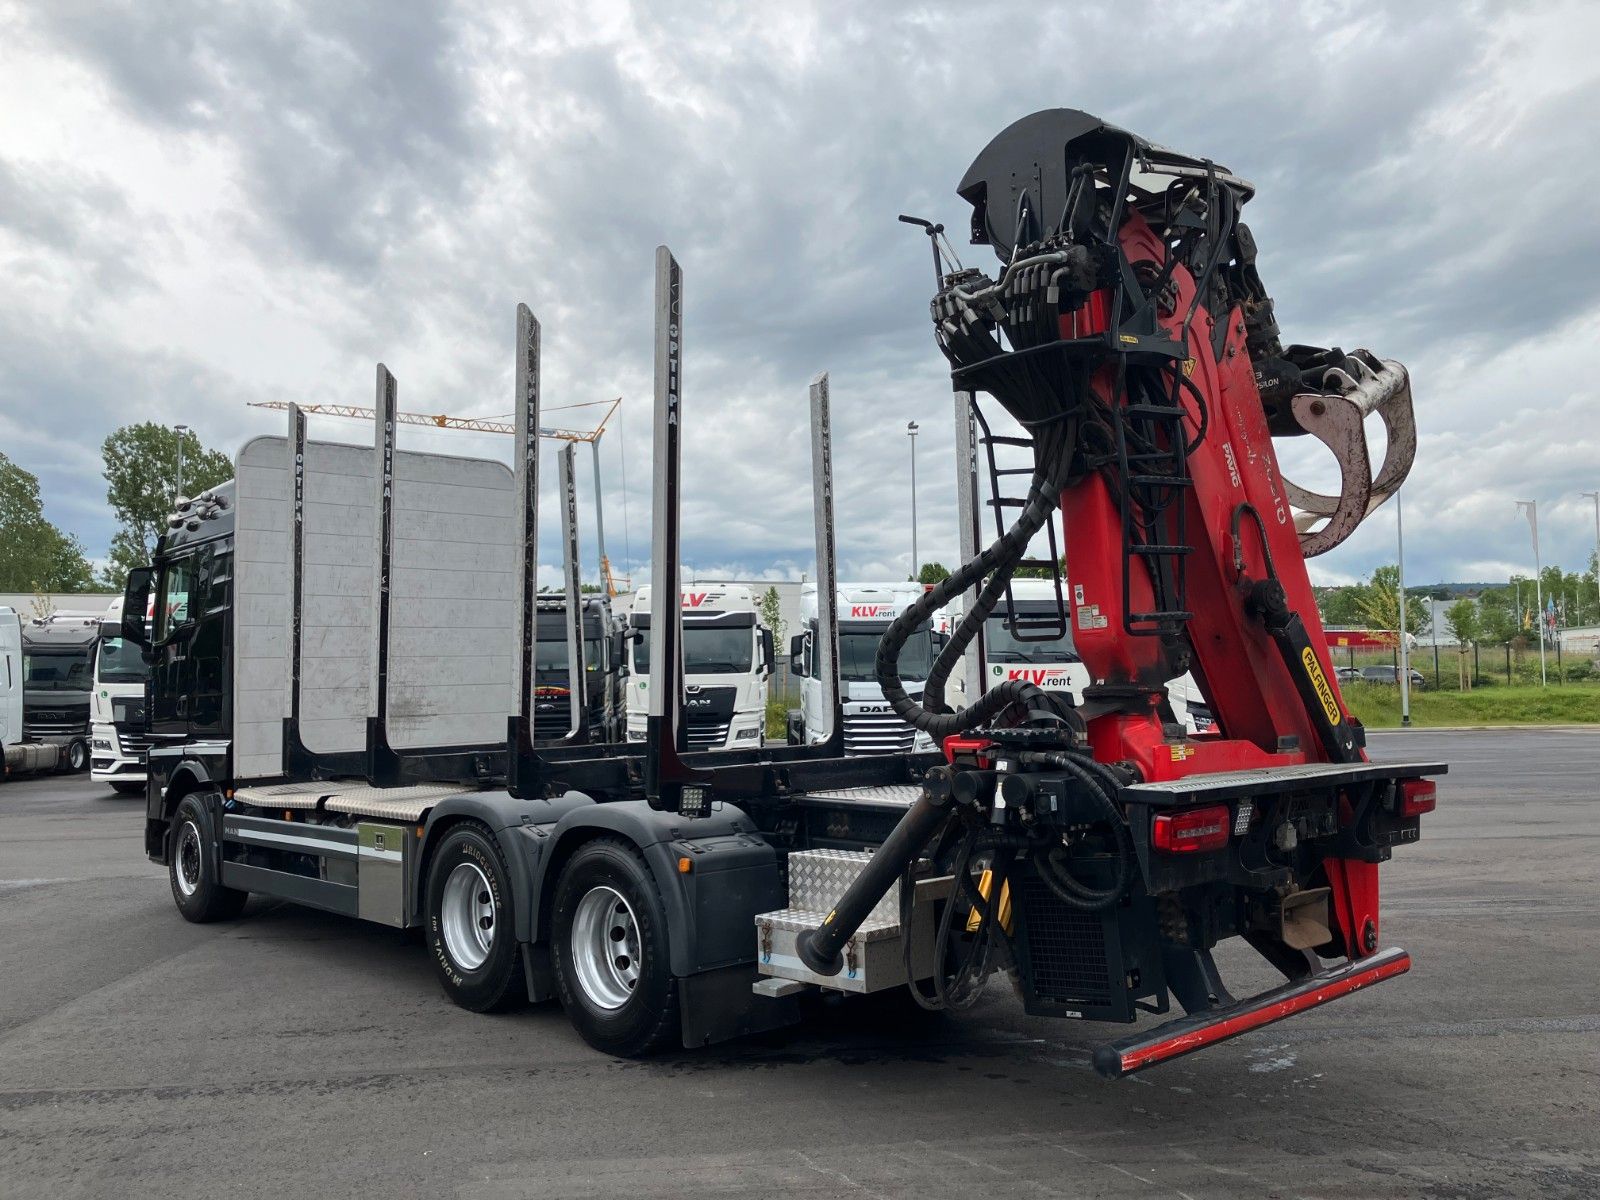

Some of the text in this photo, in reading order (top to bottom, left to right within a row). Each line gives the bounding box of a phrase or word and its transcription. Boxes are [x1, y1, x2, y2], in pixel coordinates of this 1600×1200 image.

[668, 323, 679, 426] OPTIPA
[383, 421, 392, 498] OPTIPA
[968, 405, 977, 473] PTIPA
[680, 593, 707, 608] LV
[1304, 651, 1339, 722] PALFINGER
[224, 826, 239, 835] MAN
